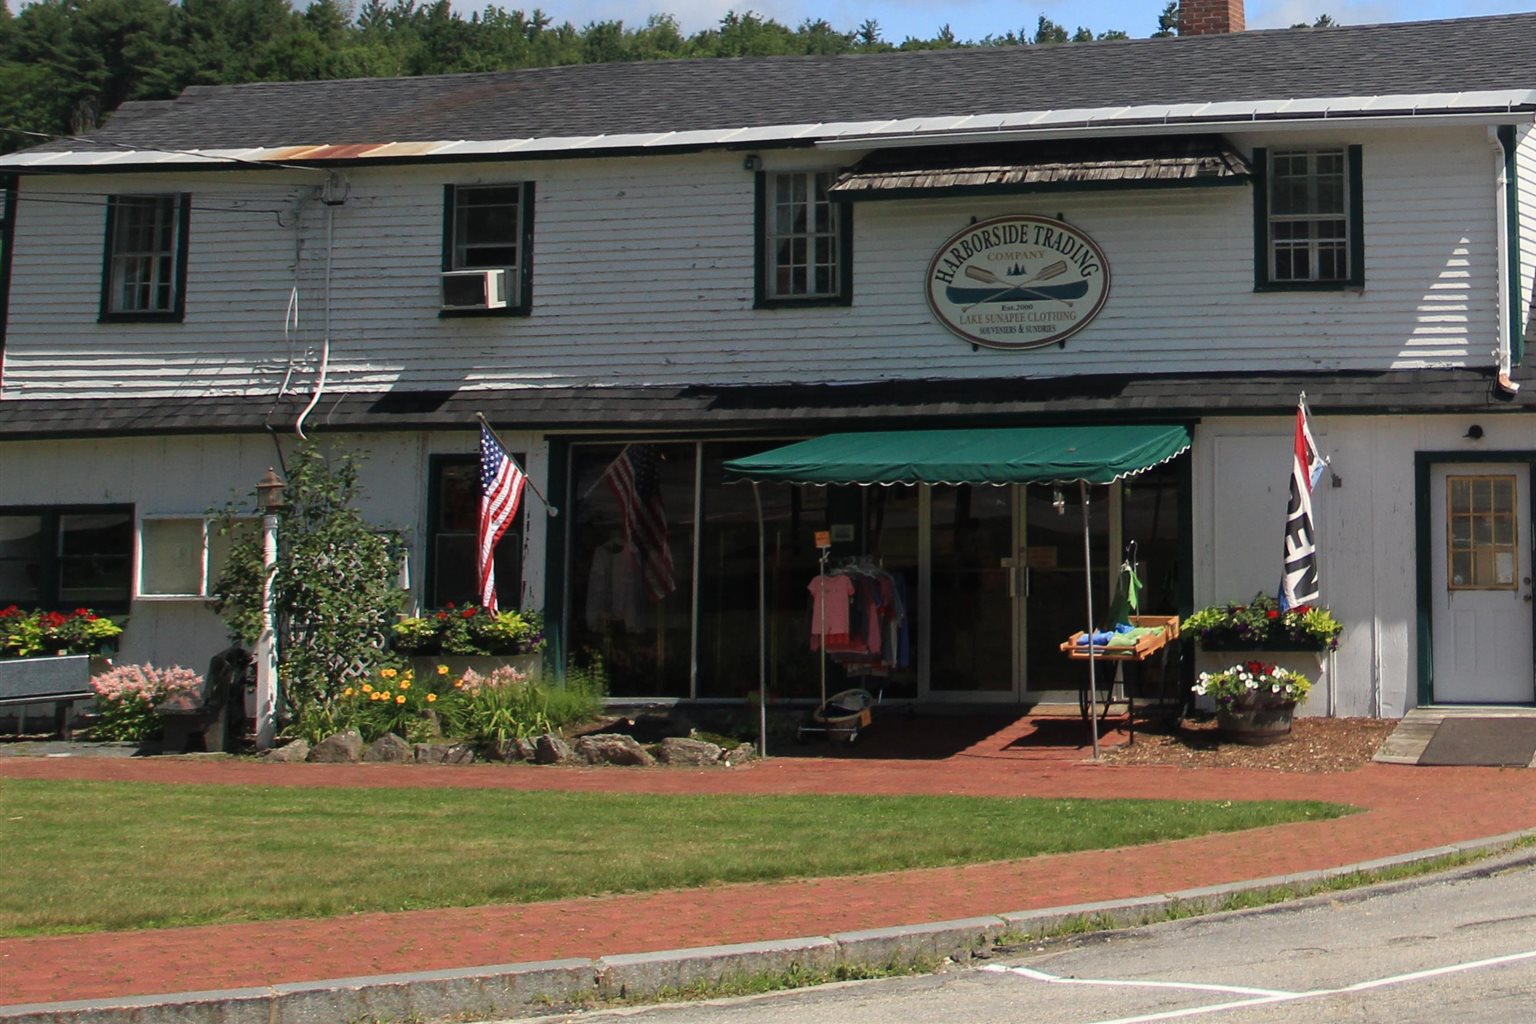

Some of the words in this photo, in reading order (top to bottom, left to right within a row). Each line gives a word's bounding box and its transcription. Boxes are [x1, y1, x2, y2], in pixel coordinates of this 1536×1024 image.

[935, 224, 1029, 285] HARBORSIDE
[1034, 225, 1099, 278] TRADING
[987, 250, 1046, 262] COMPANY
[959, 314, 983, 325] LAKE
[985, 311, 1025, 324] SUNAPEE
[1027, 311, 1077, 322] CLOTHING
[1018, 324, 1024, 334] &
[1025, 324, 1057, 334] SUNDRIES
